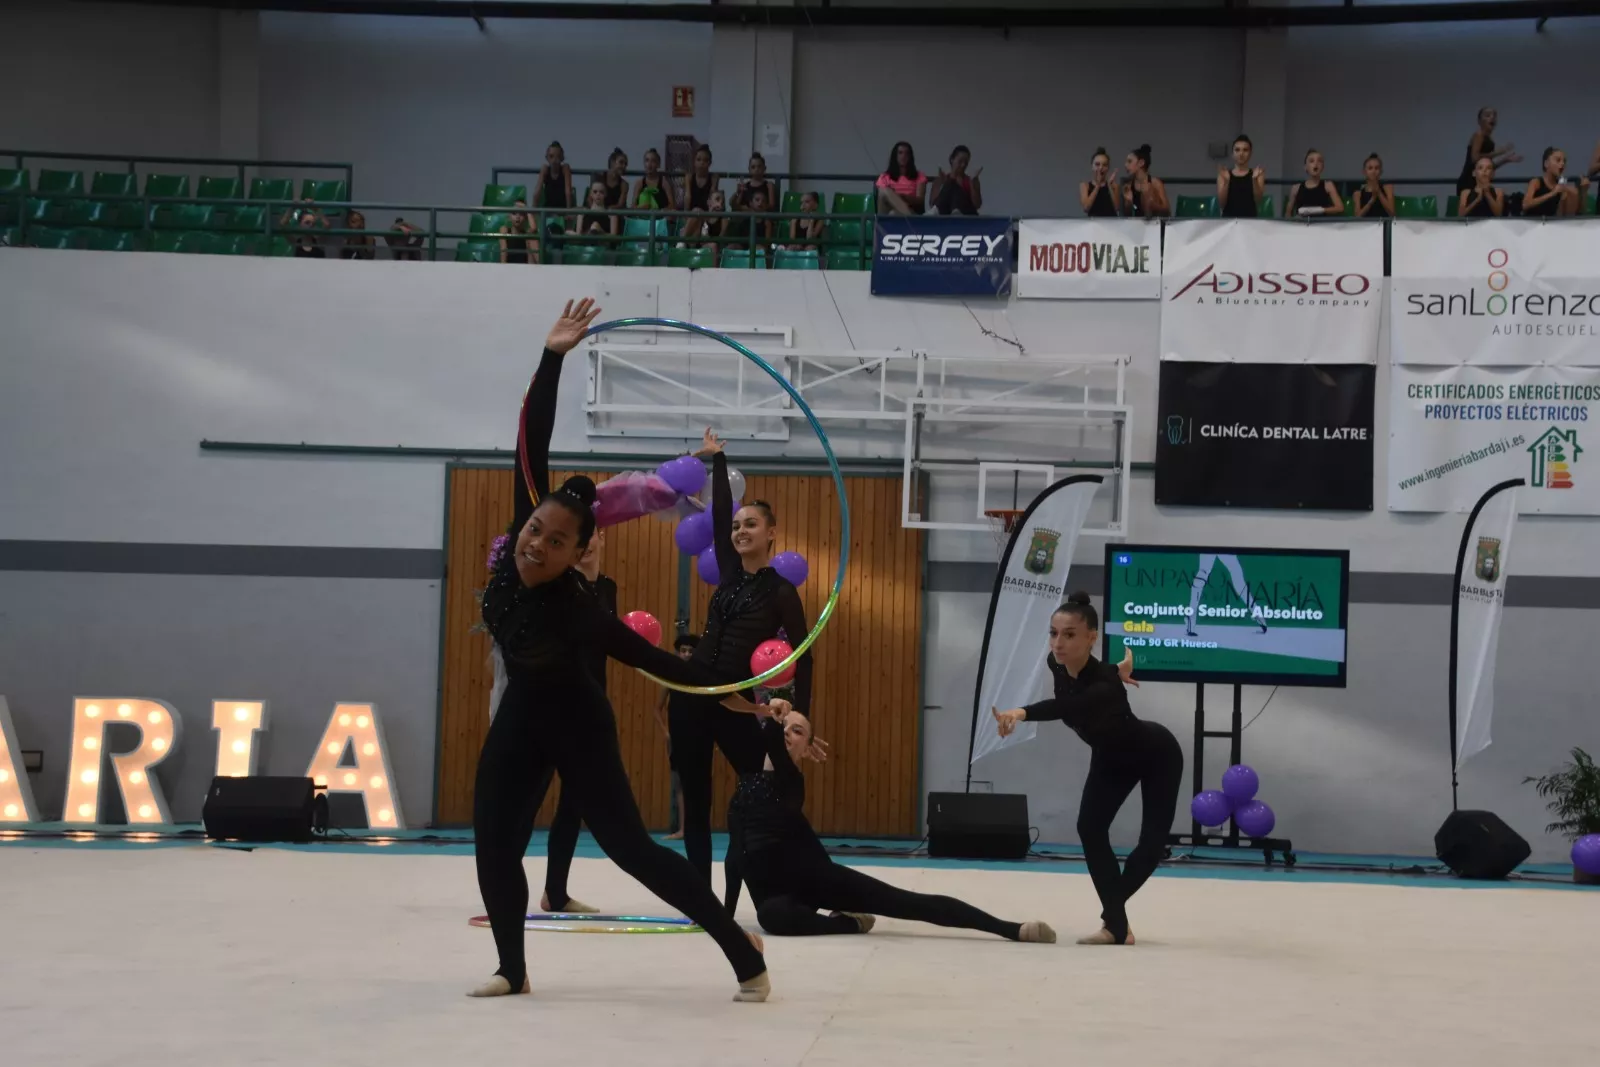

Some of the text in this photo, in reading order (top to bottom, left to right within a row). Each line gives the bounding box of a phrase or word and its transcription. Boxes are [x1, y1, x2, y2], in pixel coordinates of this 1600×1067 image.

[880, 234, 1005, 255] SERFEY
[1029, 242, 1150, 274] MODOVIAJE
[1170, 263, 1370, 301] ADISSEO
[1197, 296, 1370, 307] A Bluestar Company
[1407, 383, 1505, 400] CERTIFICADOS
[1424, 403, 1588, 421] PROYECTOS ELÉCTRICOS
[1200, 423, 1367, 440] CLINÍCA DENTAL LATRE
[1004, 576, 1062, 594] BARBASTRO
[1124, 601, 1323, 620] Conjunto Senior Absoluto
[1123, 620, 1154, 633] Gala
[1123, 637, 1218, 649] Club 90 GR Huesca
